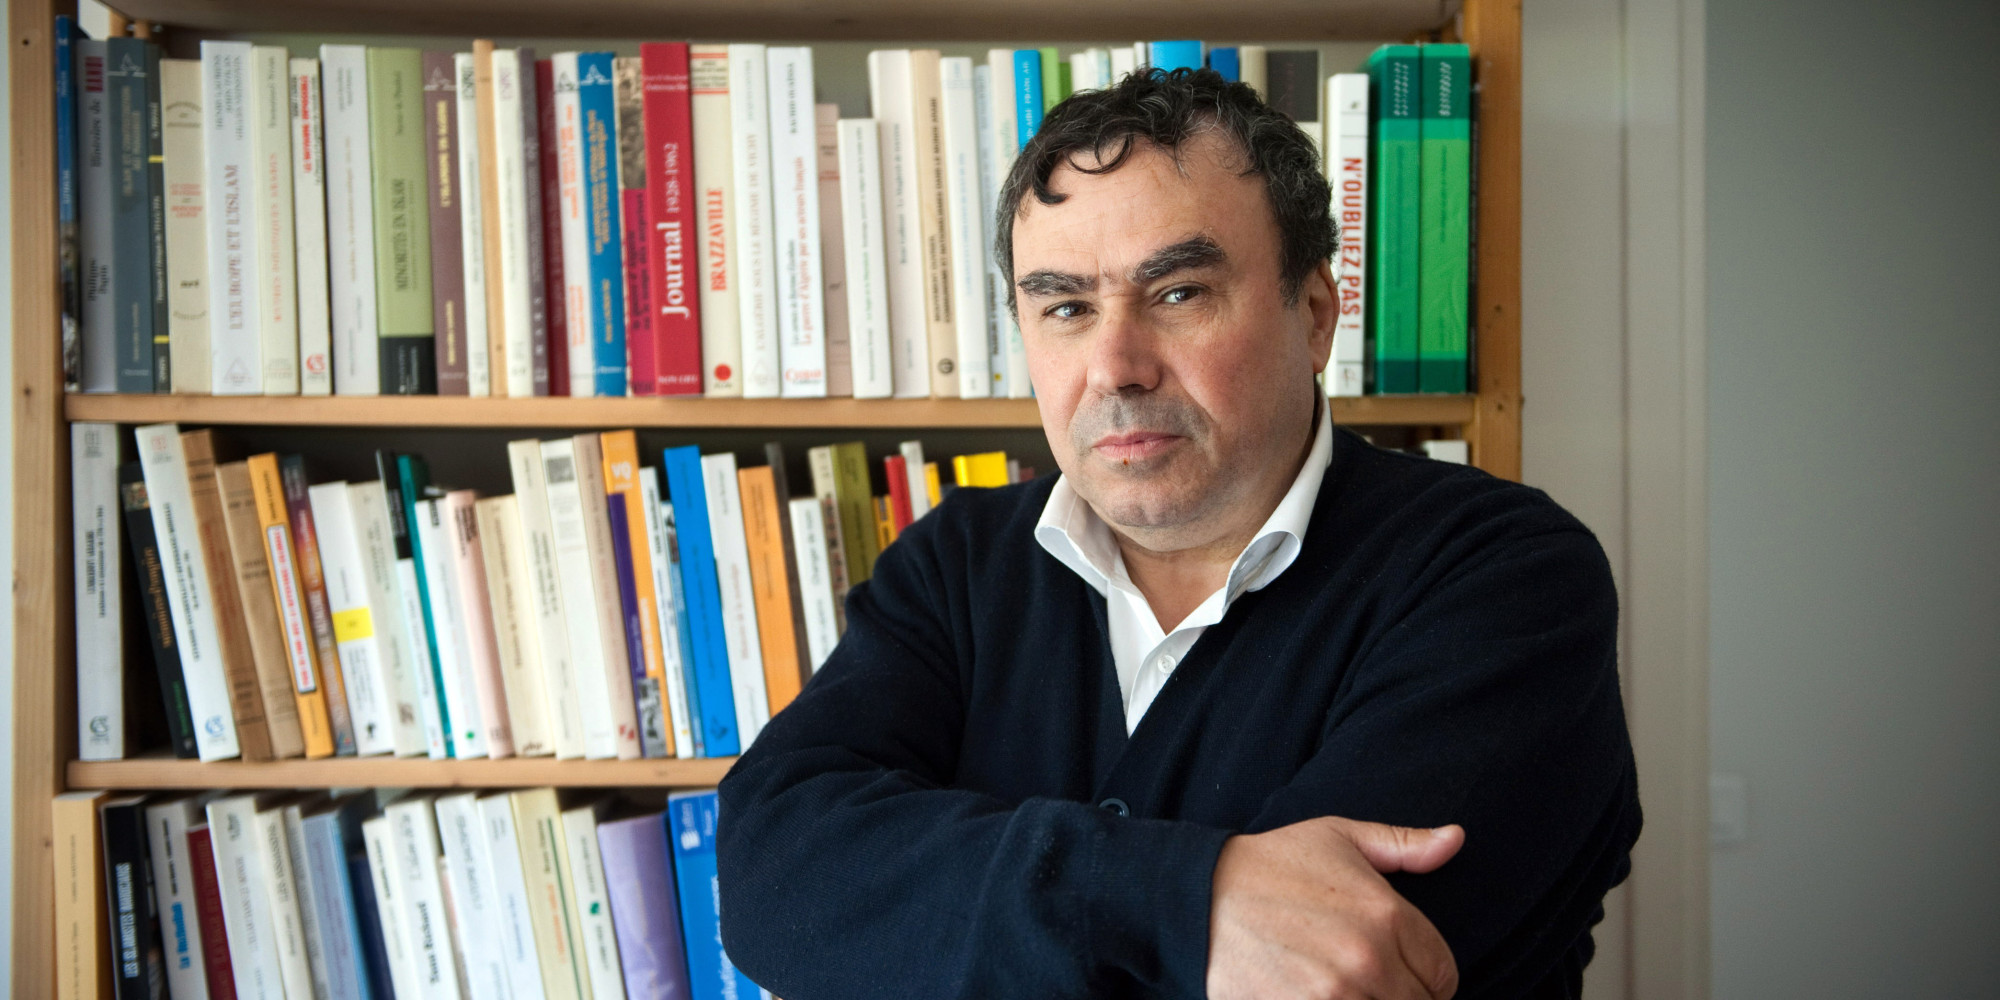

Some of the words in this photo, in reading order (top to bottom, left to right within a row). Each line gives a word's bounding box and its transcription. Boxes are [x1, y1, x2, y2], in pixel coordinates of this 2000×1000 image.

[223, 164, 240, 226] L'ISLAM
[664, 143, 682, 214] 1928-1962
[1341, 157, 1363, 267] N'OUBLIEZ
[225, 230, 241, 251] ET
[655, 222, 690, 321] Journal
[705, 187, 727, 292] BRAZZAVILLE
[226, 254, 242, 330] L'EUROPE
[1340, 275, 1361, 317] PAS
